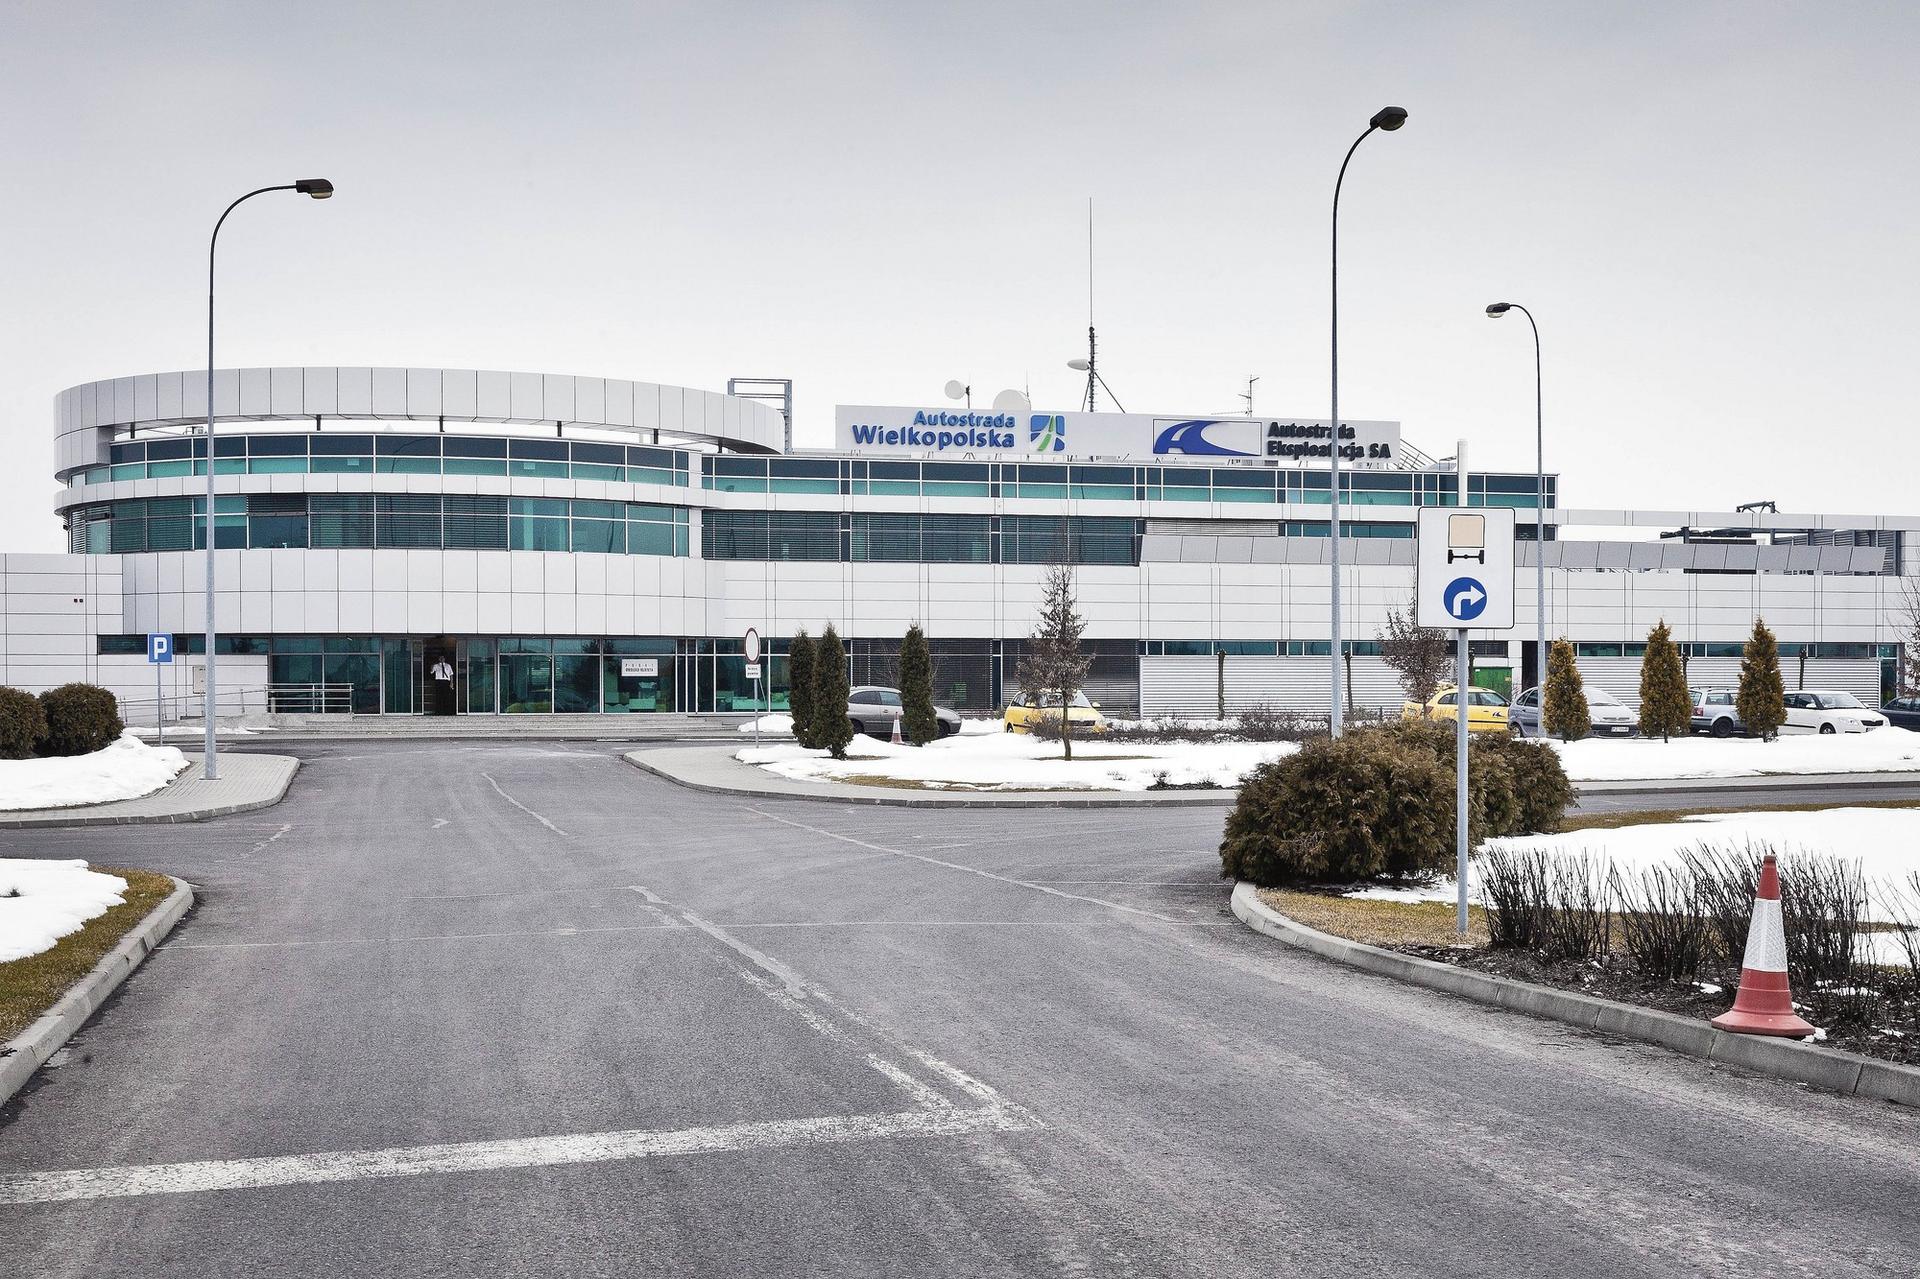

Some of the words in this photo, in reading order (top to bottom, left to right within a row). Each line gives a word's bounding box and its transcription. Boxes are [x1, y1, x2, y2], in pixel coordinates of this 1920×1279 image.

[913, 410, 1015, 428] Autostrada
[852, 425, 1015, 451] Wielkopolska
[1267, 421, 1355, 439] Autostrada
[1369, 443, 1391, 458] SA
[153, 637, 167, 660] P
